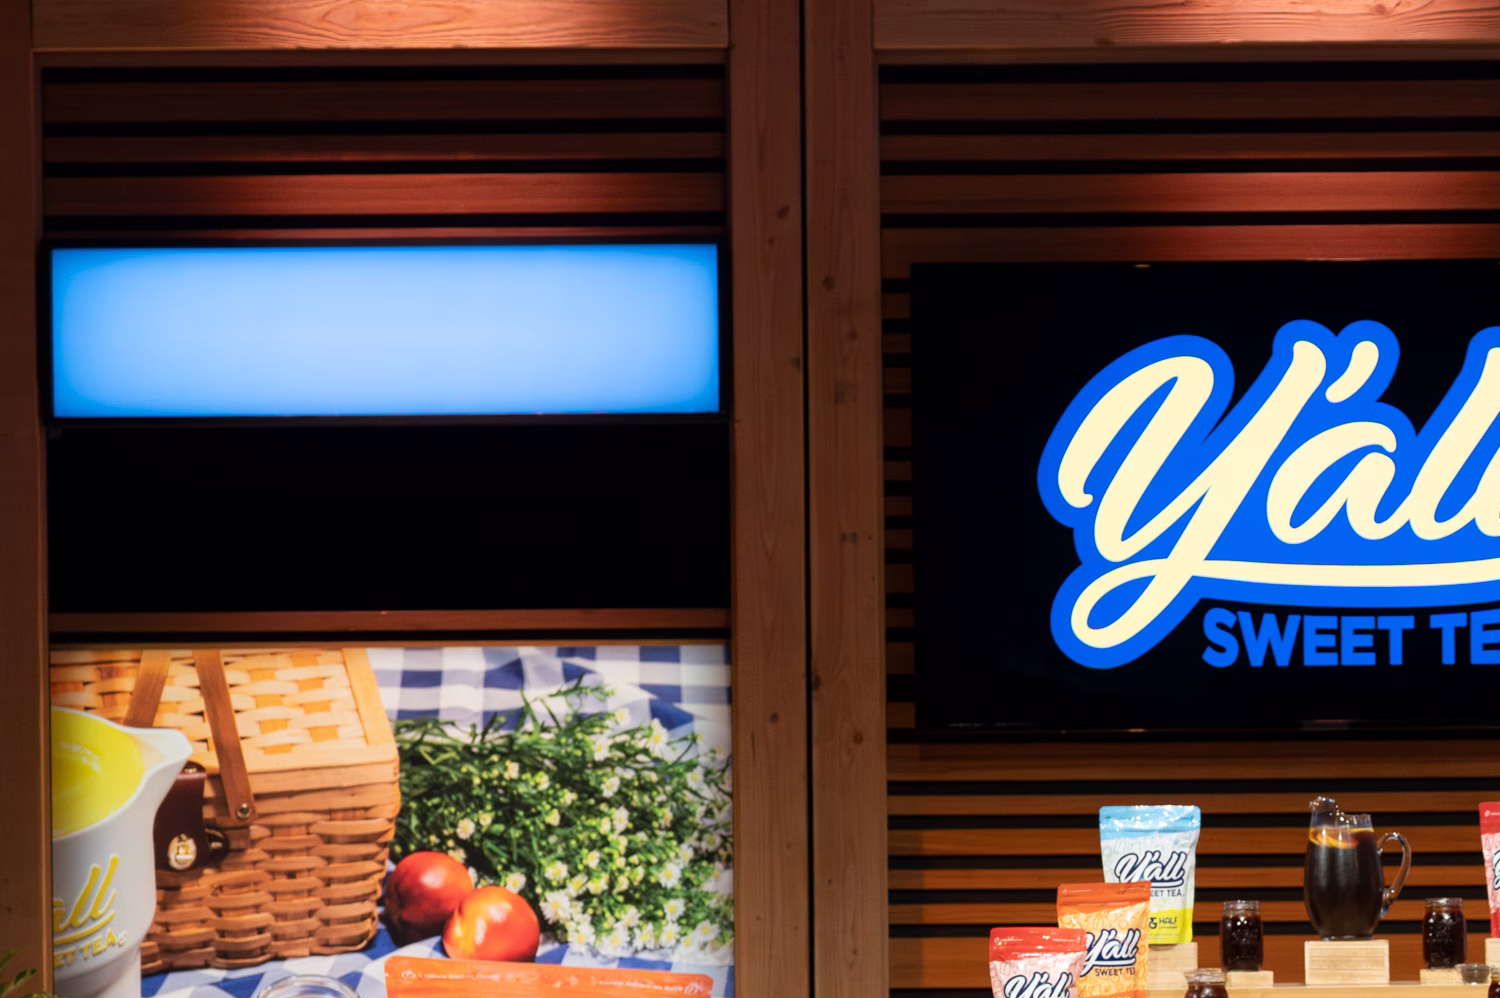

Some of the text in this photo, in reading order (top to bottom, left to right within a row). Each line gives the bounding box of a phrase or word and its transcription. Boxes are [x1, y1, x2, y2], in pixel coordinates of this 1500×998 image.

[1202, 607, 1414, 668] SWEET
[1114, 850, 1187, 888] Y'all
[1150, 889, 1182, 897] EET TEA
[1080, 928, 1141, 977] Y'all
[1095, 968, 1122, 976] SWEET
